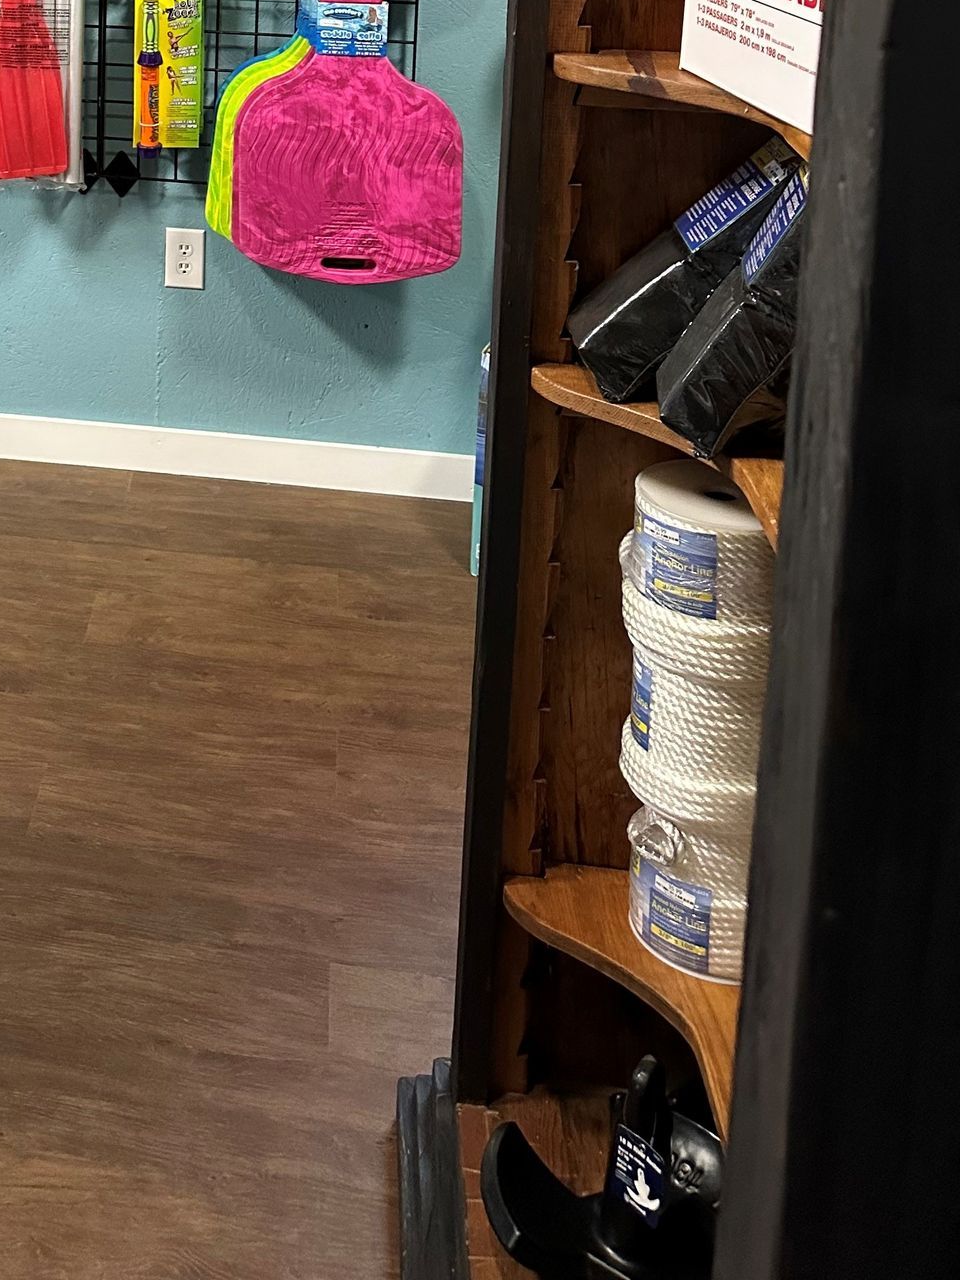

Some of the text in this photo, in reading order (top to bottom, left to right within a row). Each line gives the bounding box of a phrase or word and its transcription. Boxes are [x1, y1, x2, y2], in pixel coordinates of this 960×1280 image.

[741, 8, 745, 16] x
[697, 3, 705, 14] 1-3
[706, 6, 738, 27] PASSAGERS
[740, 21, 745, 30] 2
[751, 27, 755, 35] x
[765, 33, 770, 41] m
[696, 16, 704, 27] 1-3
[705, 19, 737, 41] PASAJEROS
[739, 35, 750, 47] 200
[751, 42, 760, 51] cm
[761, 45, 765, 53] x
[766, 46, 776, 58] 198
[777, 53, 786, 62] cm
[690, 565, 713, 578] Line
[685, 916, 707, 931] Line
